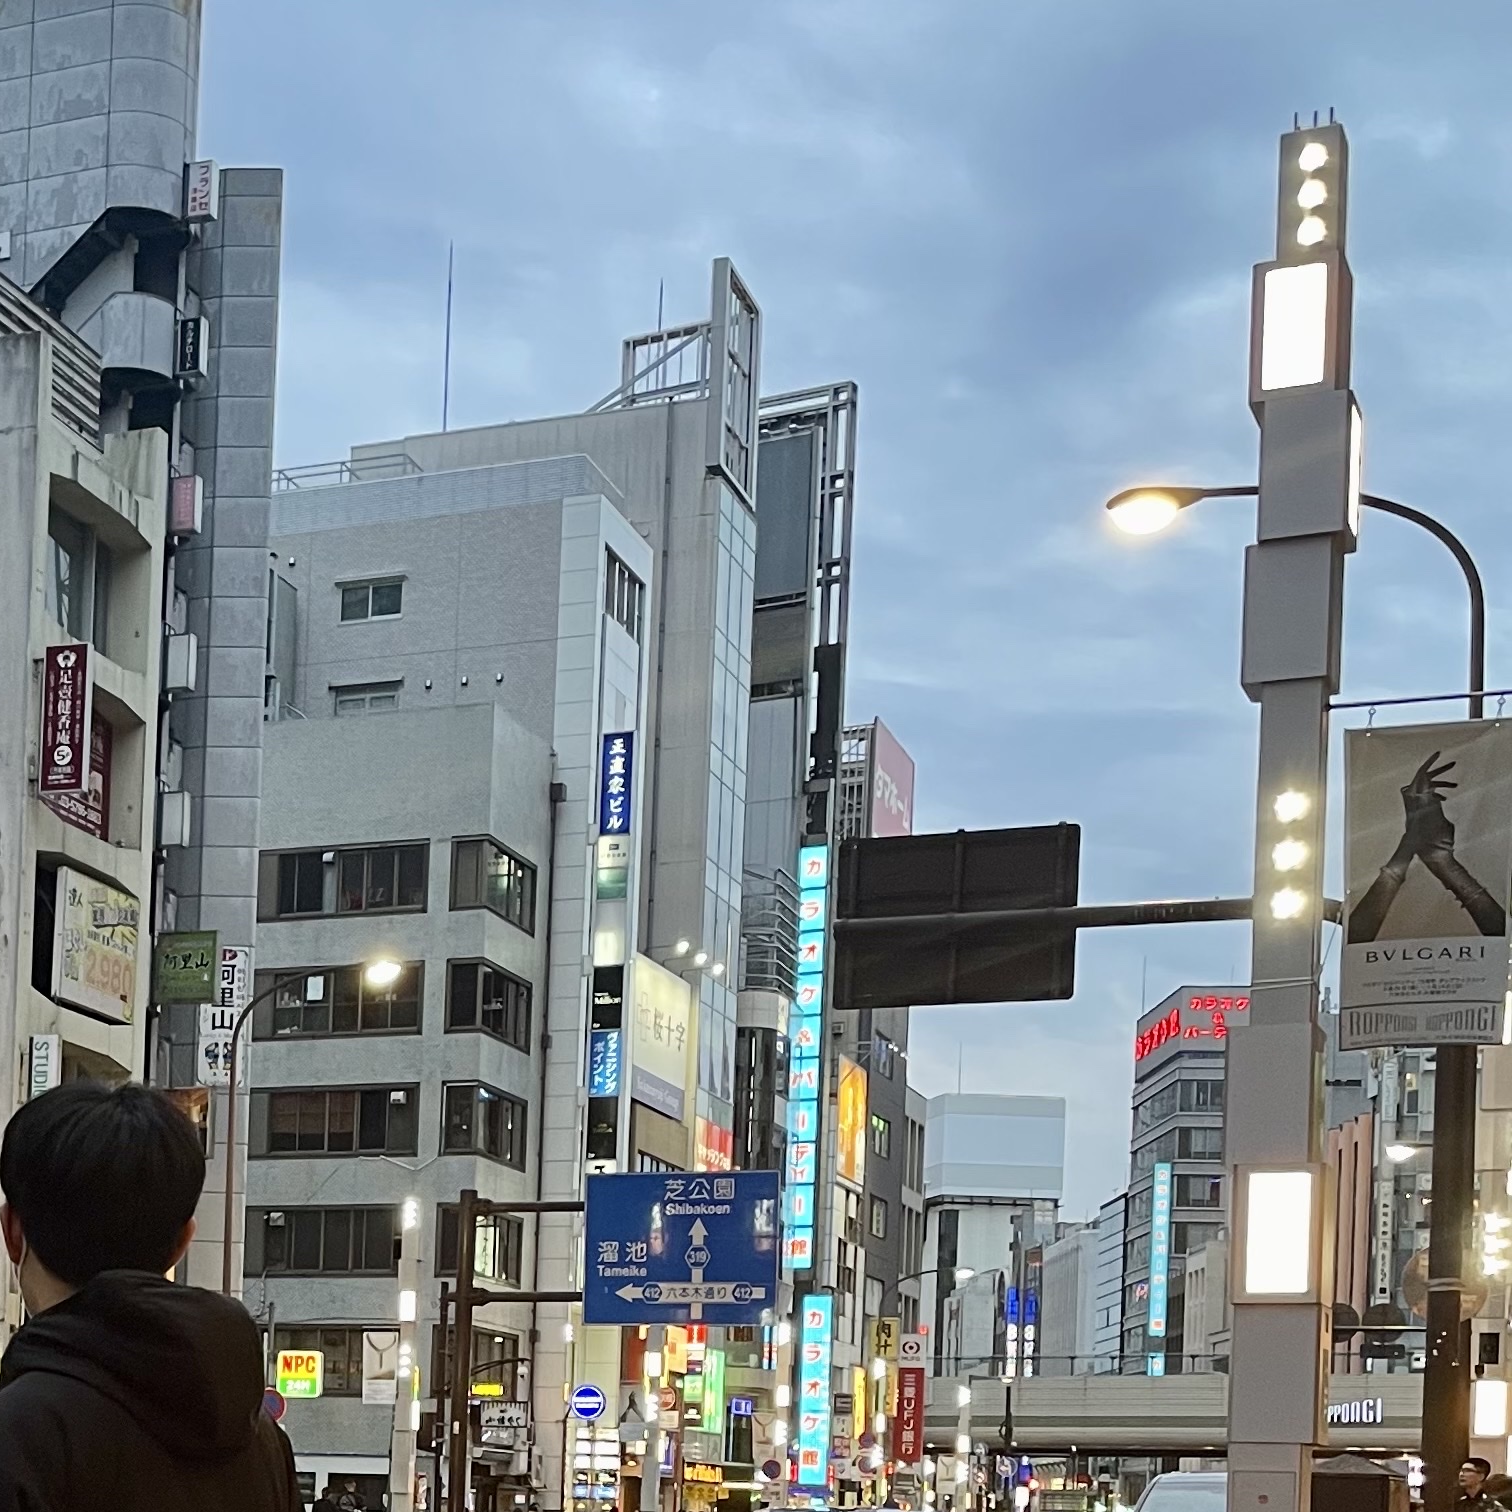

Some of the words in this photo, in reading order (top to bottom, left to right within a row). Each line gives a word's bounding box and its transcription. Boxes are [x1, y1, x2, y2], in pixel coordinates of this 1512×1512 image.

[164, 951, 210, 970] 阿里山
[1366, 946, 1485, 963] BVLGARI
[664, 1178, 735, 1201] 芝公園
[665, 1203, 731, 1216] Shibakoen
[597, 1241, 647, 1263] 溜池
[688, 1251, 707, 1263] 319
[597, 1265, 647, 1277] Tameike
[644, 1288, 662, 1299] 412
[665, 1287, 727, 1299] 六本木通り
[734, 1288, 752, 1299] 412
[282, 1355, 316, 1373] NPC
[802, 1311, 823, 1466] カラオケ館
